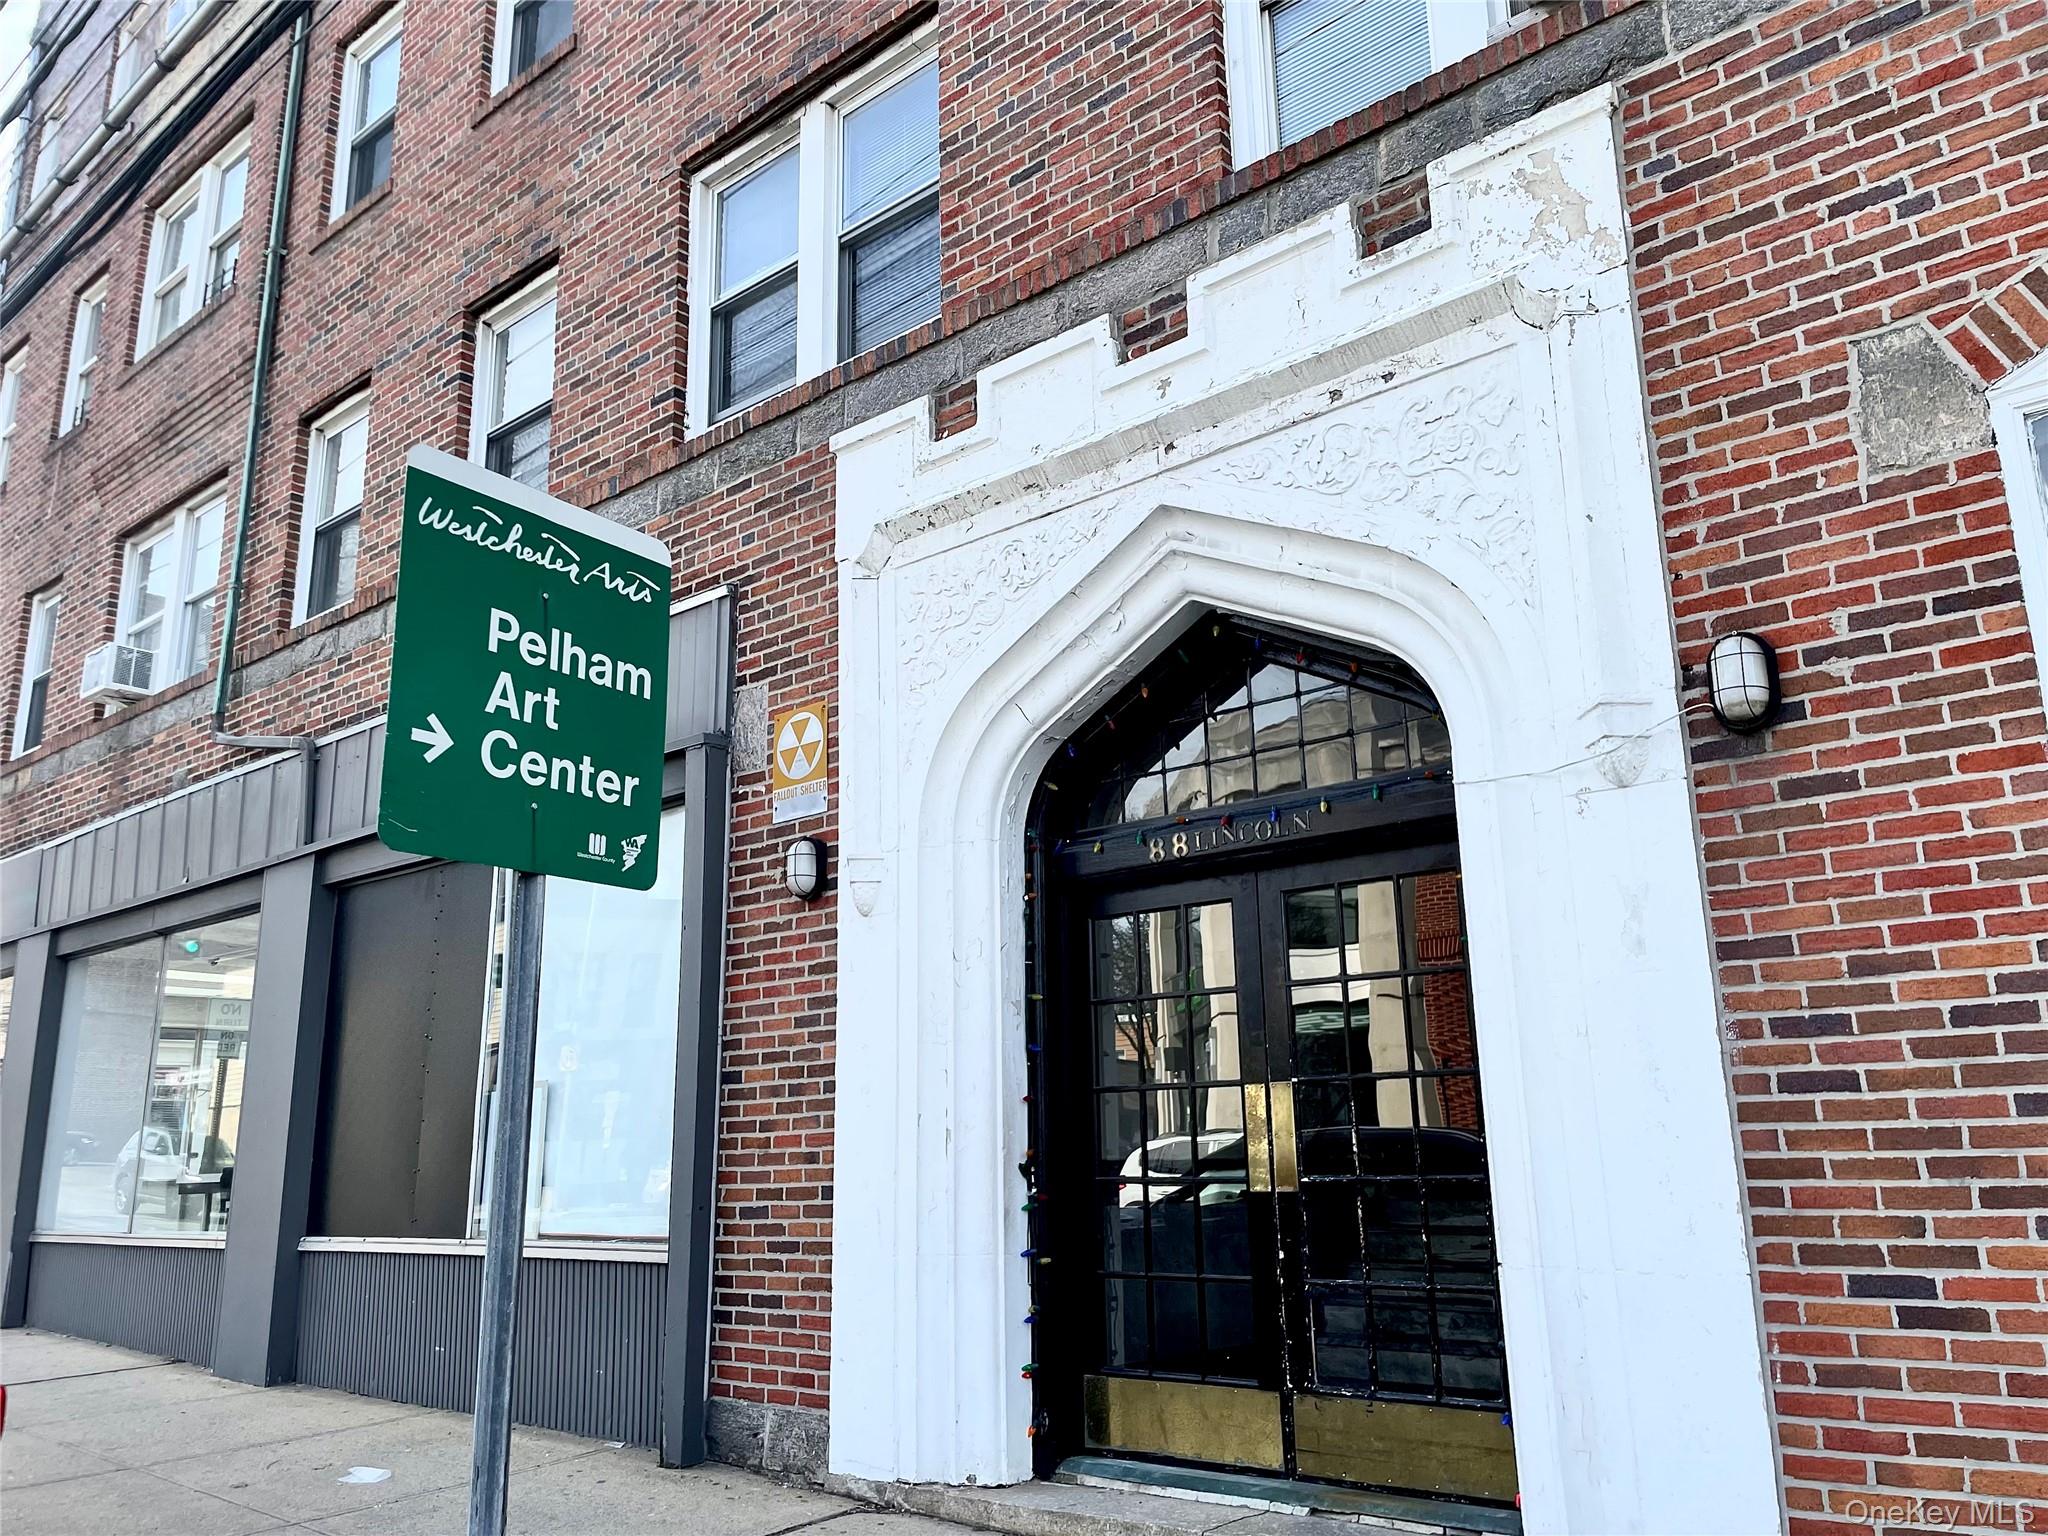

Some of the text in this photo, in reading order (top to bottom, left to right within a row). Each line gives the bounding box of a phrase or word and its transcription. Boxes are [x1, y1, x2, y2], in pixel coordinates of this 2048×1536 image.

[418, 496, 661, 603] Westchester Arts
[487, 607, 652, 700] Pelham
[484, 671, 561, 731] Art
[480, 729, 640, 807] Center
[773, 780, 827, 802] FALLOUT SHELTER
[1149, 810, 1312, 863] 88 LINCOLN
